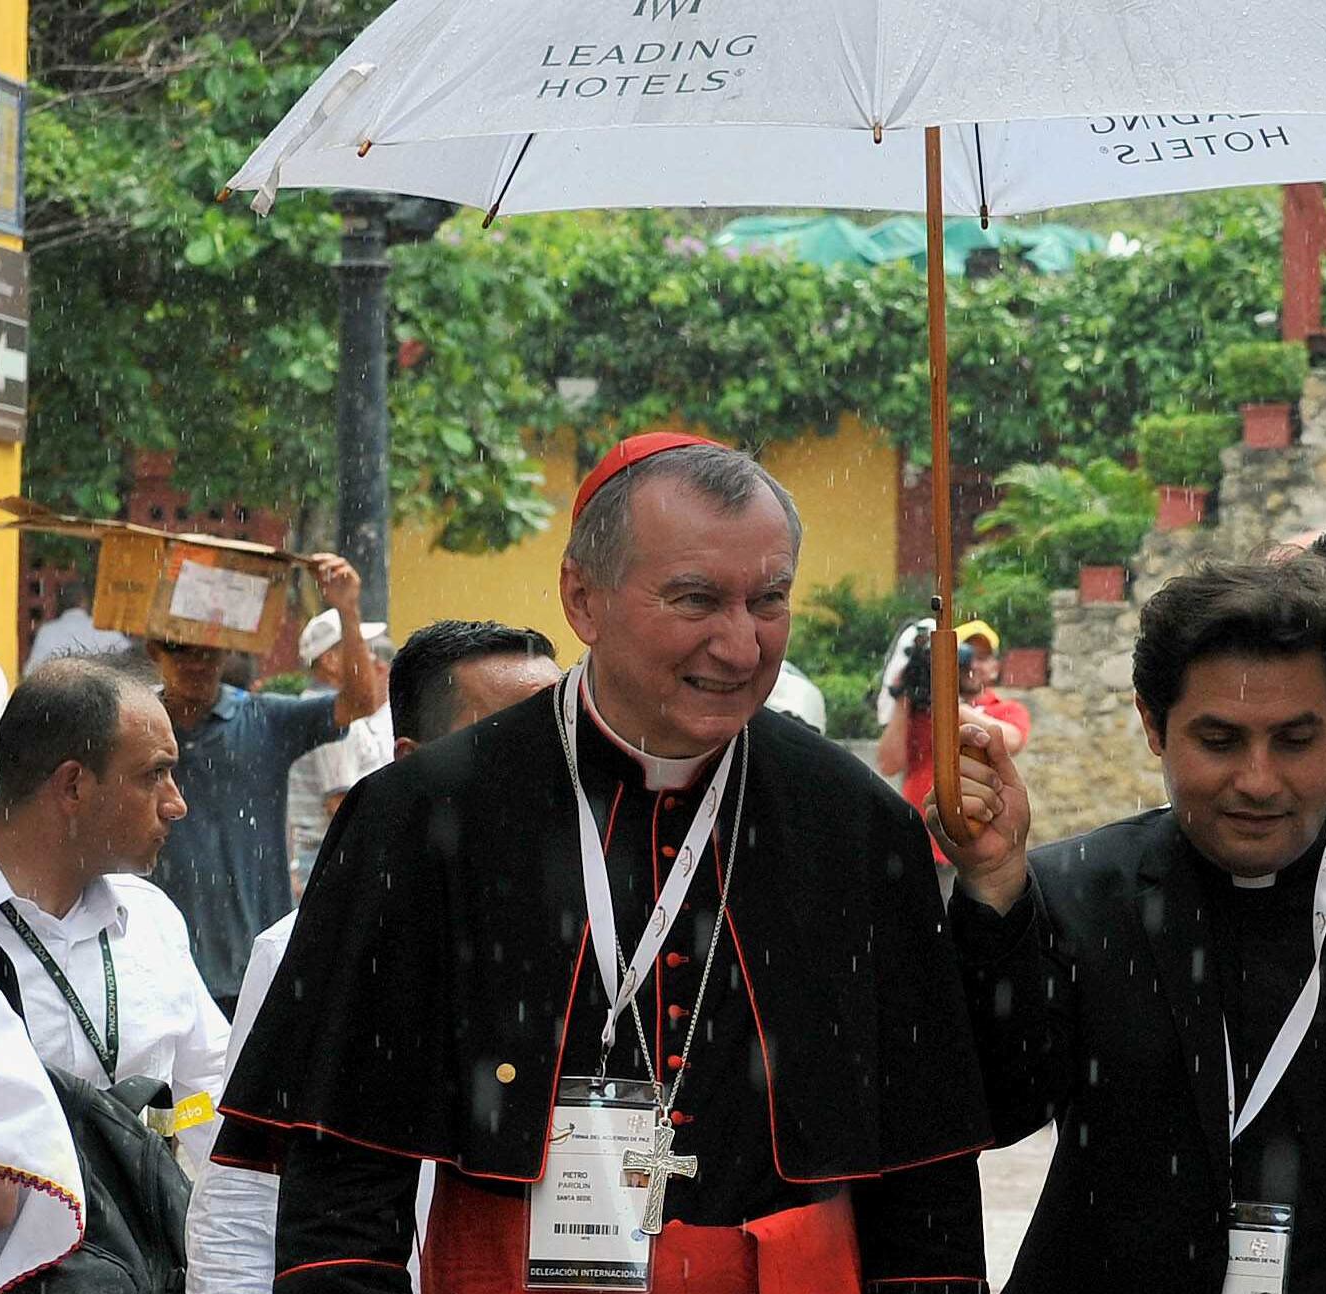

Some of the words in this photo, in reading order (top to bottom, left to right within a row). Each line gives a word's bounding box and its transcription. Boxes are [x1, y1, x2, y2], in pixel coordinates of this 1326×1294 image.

[541, 34, 758, 67] LEADING
[104, 960, 114, 989] POLICIA
[65, 986, 90, 1029] NACIONAL
[107, 991, 115, 1036] NACIONAL
[563, 1171, 588, 1179] PIETRO
[580, 1268, 646, 1279] INTERNACIONAL
